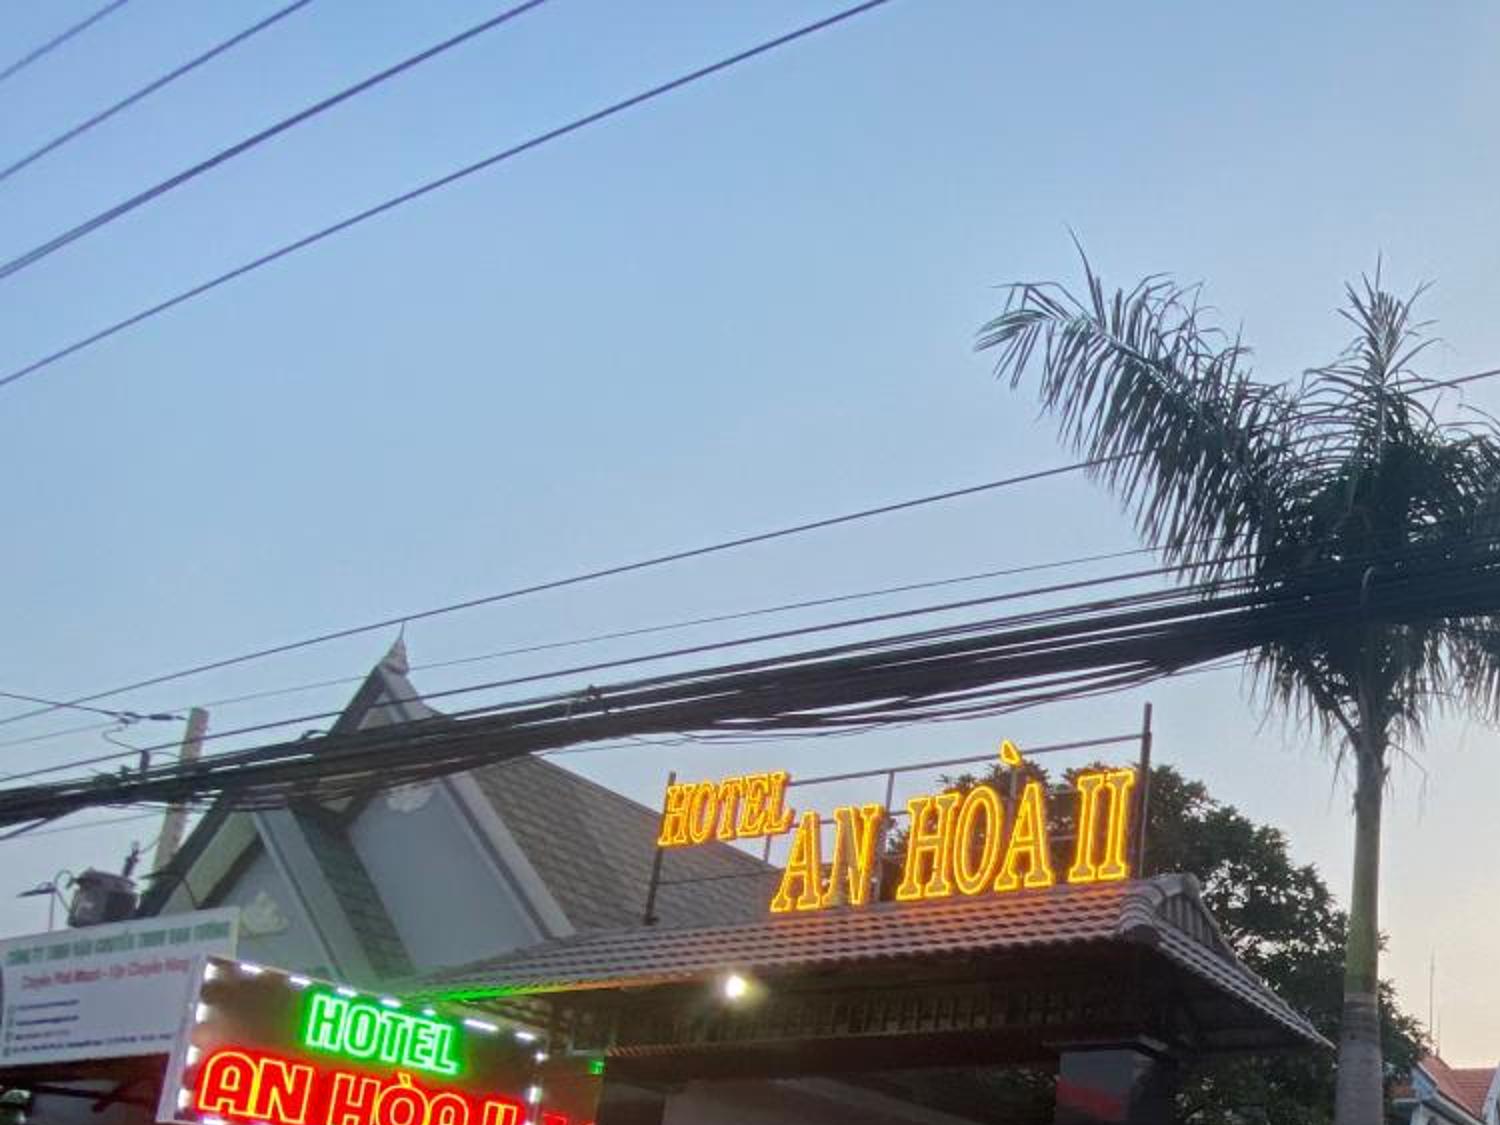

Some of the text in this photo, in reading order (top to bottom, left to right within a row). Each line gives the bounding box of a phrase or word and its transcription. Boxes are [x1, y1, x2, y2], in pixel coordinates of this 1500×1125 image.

[657, 768, 793, 846] HOTEL
[769, 803, 885, 913] AN
[1067, 769, 1136, 883] II
[306, 993, 459, 1076] HOTEL
[198, 1051, 314, 1125] AN
